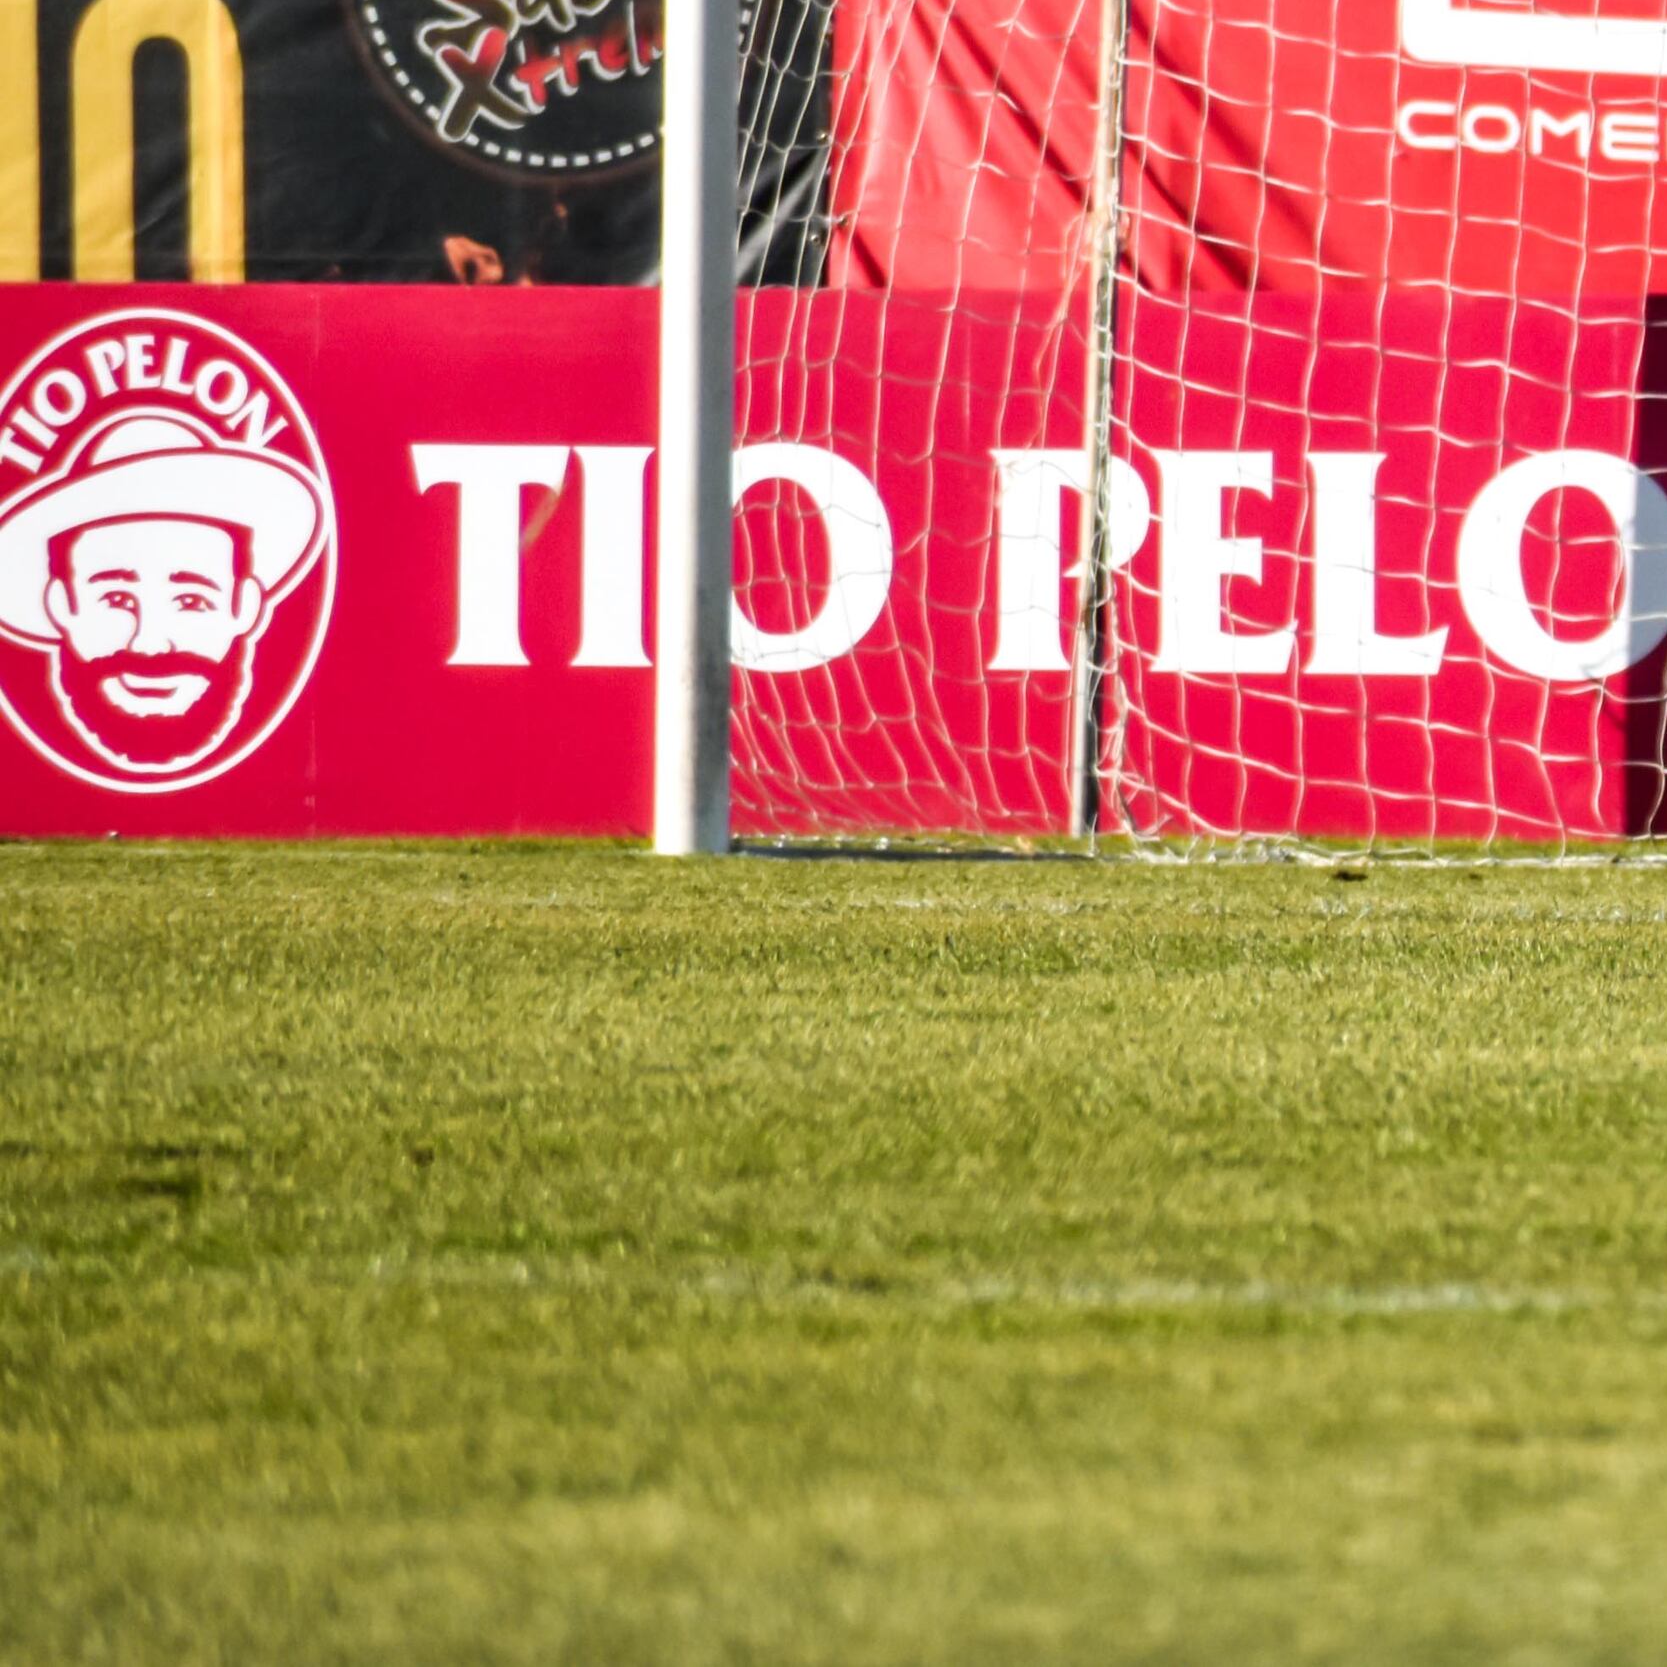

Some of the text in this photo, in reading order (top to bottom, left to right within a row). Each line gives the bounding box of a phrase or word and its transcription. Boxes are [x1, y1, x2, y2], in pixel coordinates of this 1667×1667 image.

[0, 333, 289, 474] TIO PELON
[409, 441, 894, 675] TIO
